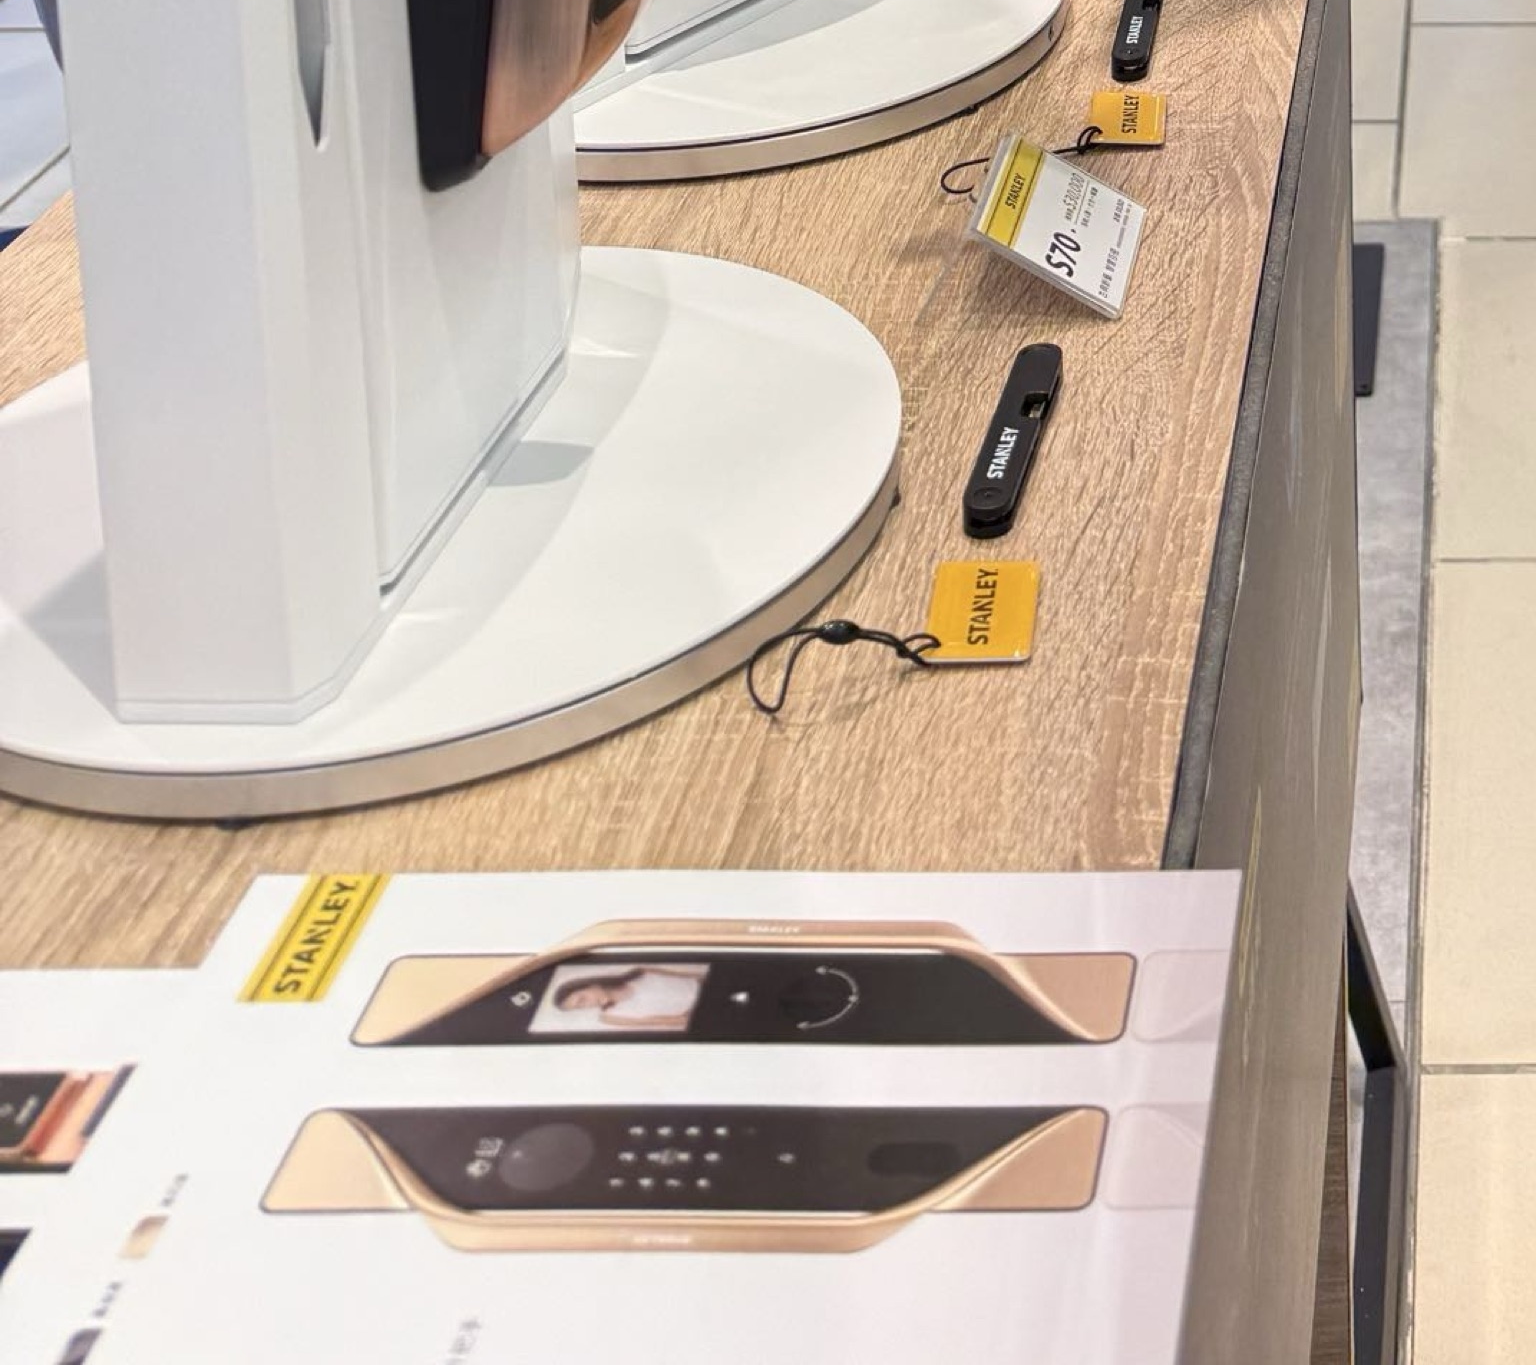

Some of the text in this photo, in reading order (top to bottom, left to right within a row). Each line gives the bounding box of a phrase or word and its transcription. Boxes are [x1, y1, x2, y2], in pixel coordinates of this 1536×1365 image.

[1126, 16, 1143, 45] STANLEY
[1121, 94, 1141, 134] STANLEY
[1004, 173, 1027, 209] STANLEY
[1044, 227, 1083, 278] S70
[986, 426, 1021, 480] STANLEY
[967, 568, 1000, 646] STANLEY
[272, 879, 358, 994] STANLEY
